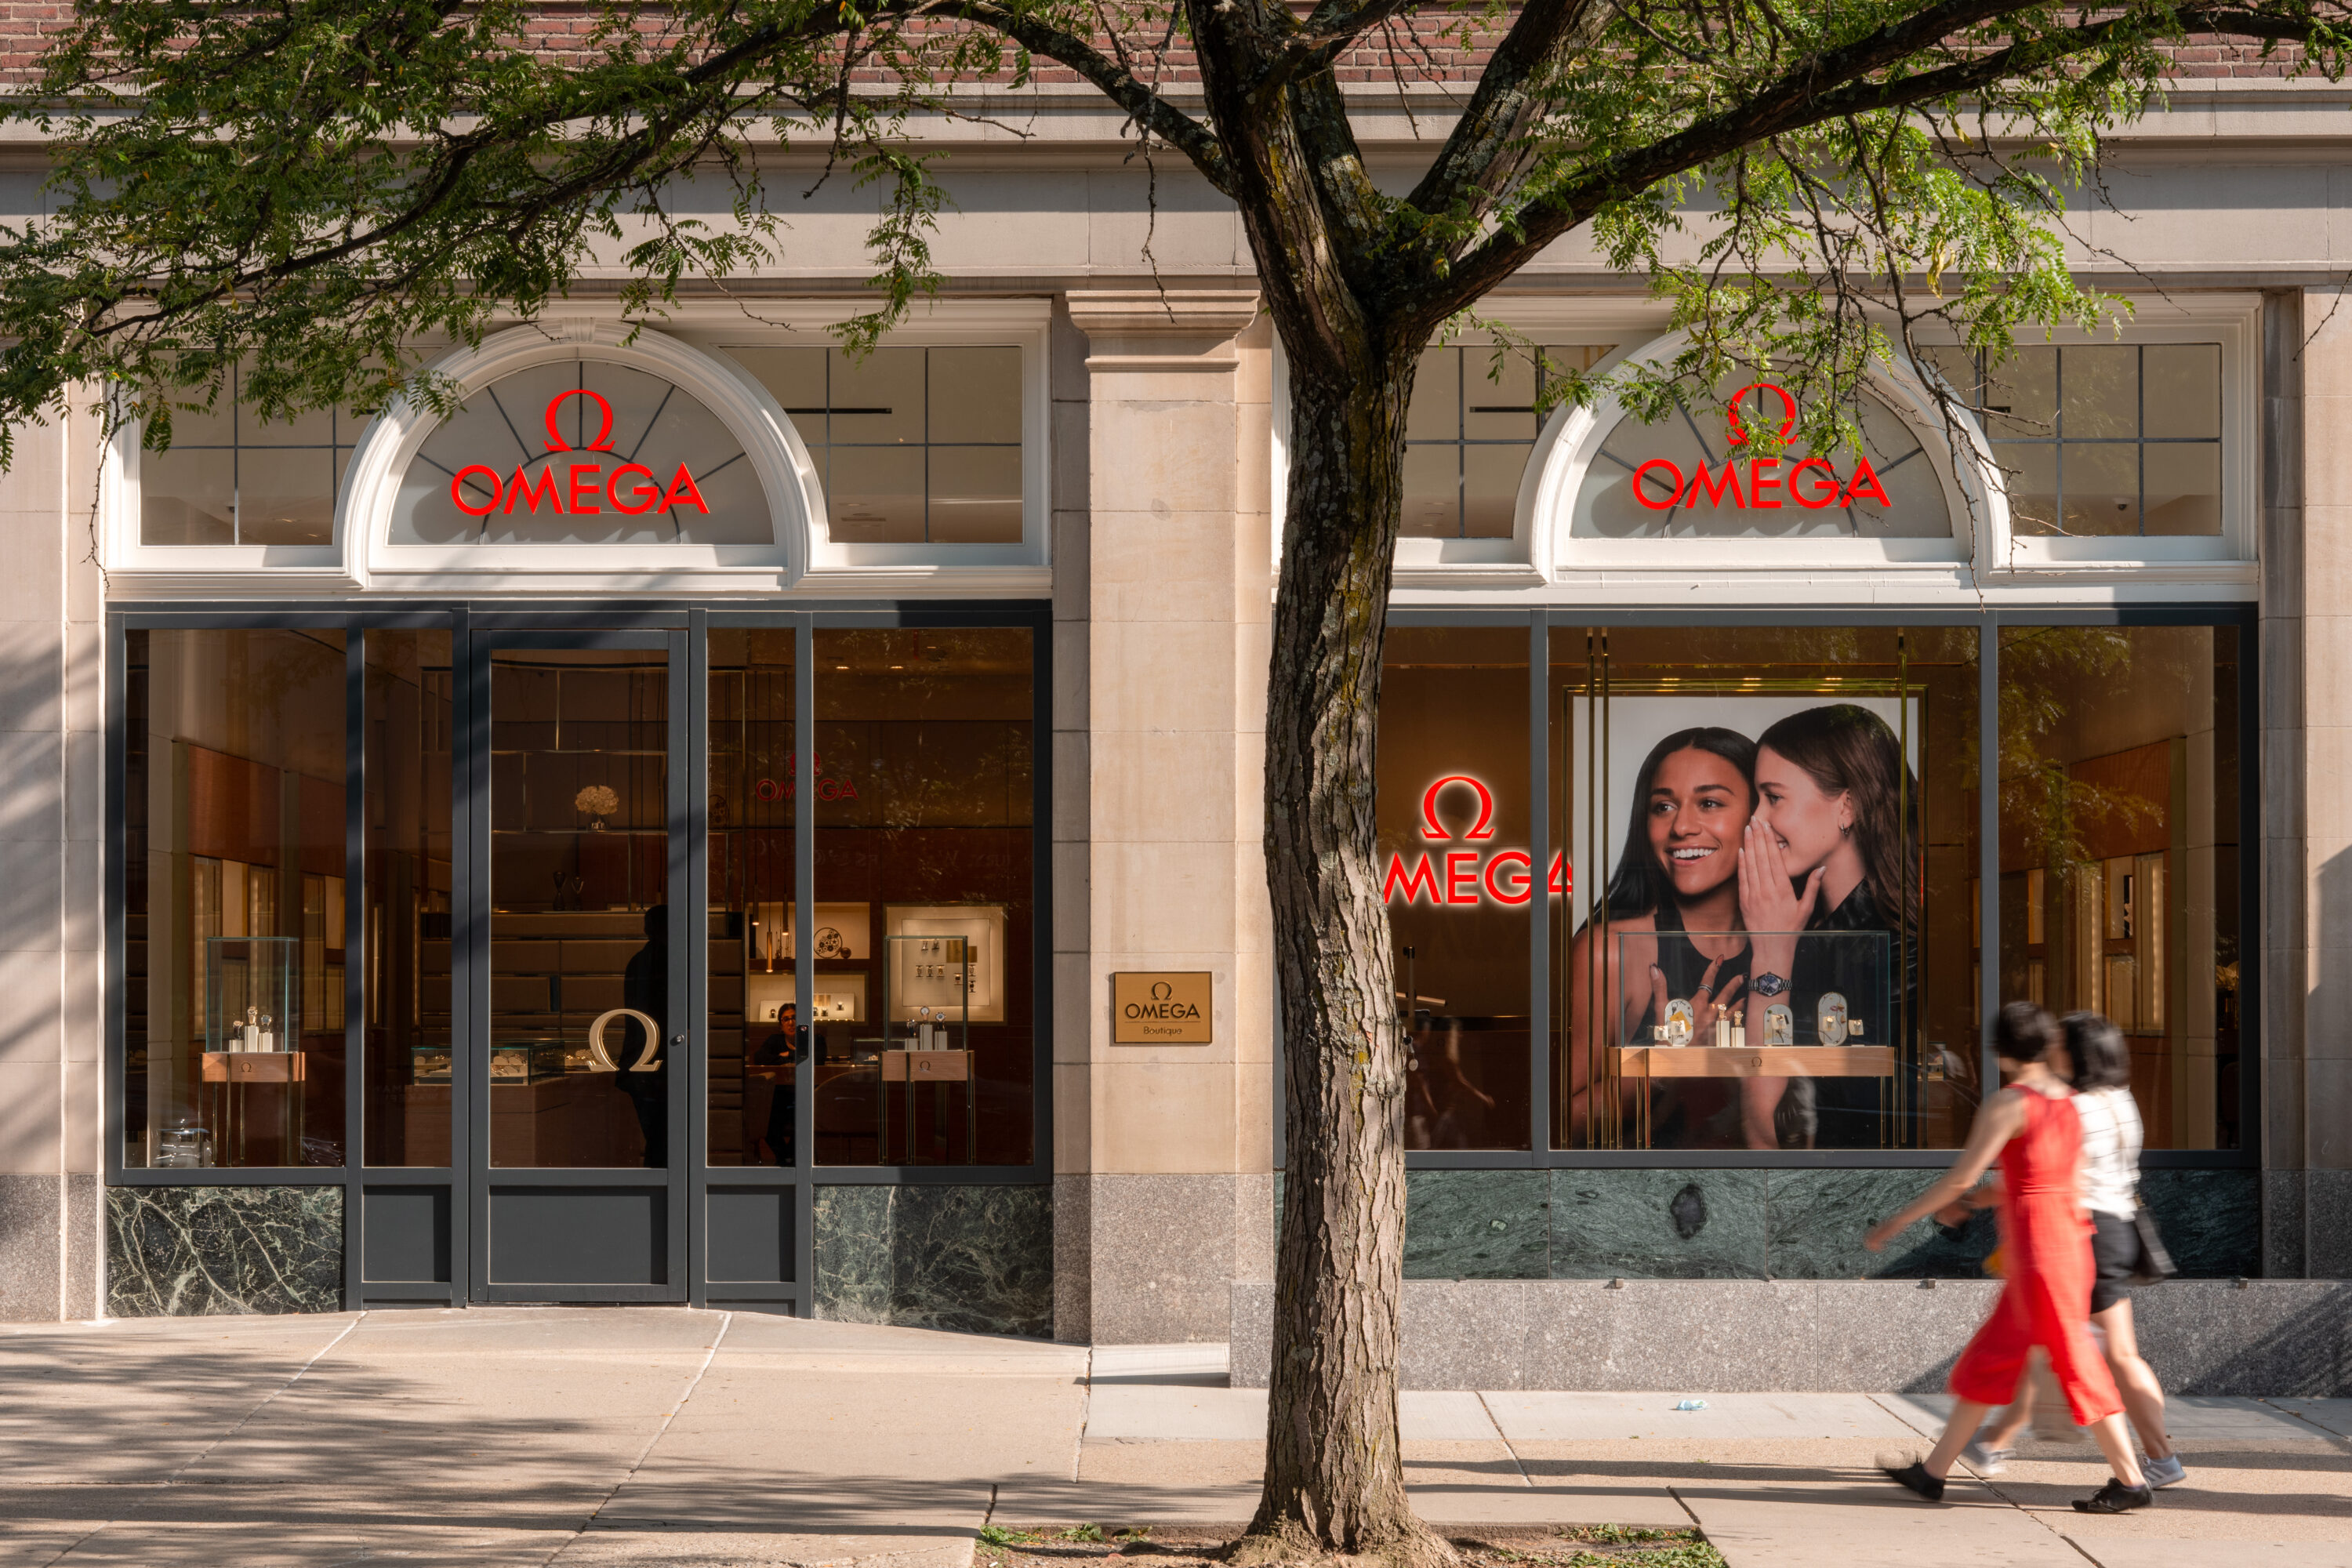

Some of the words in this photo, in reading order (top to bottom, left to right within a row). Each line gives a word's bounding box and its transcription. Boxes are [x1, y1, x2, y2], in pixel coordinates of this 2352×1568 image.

[451, 462, 710, 516] OMEGA
[1632, 456, 1892, 510] OMEGA
[756, 778, 859, 801] OMGA
[1383, 851, 1573, 905] MEGA
[1124, 1003, 1201, 1019] OMEGA
[1143, 1025, 1183, 1036] Boutique
